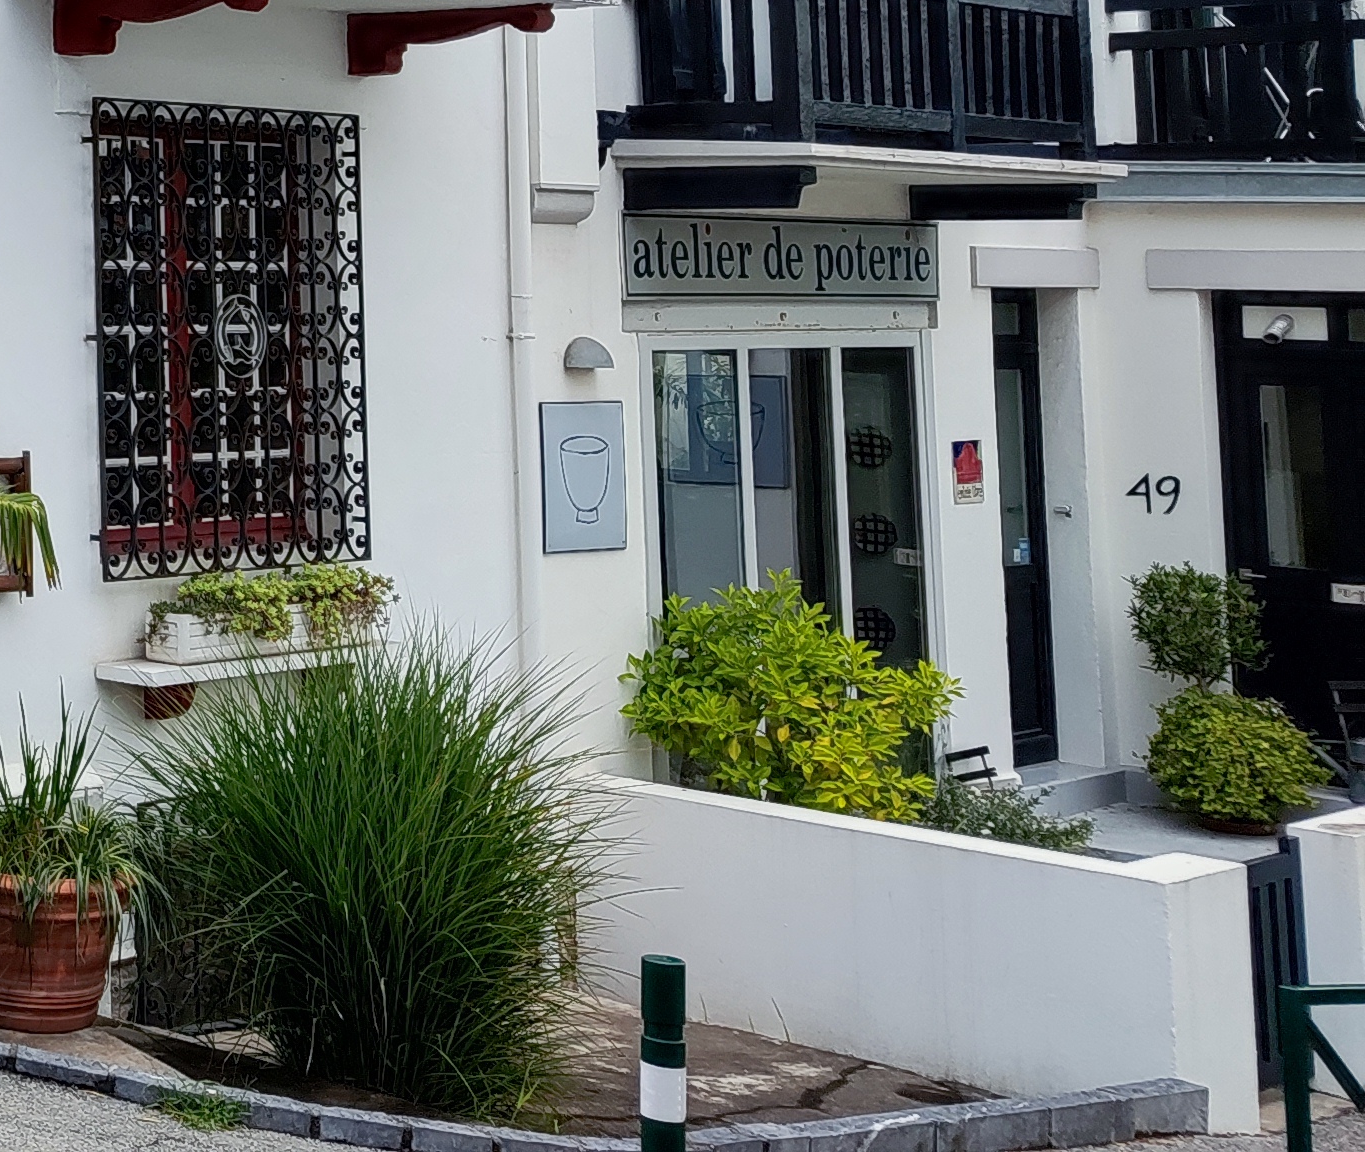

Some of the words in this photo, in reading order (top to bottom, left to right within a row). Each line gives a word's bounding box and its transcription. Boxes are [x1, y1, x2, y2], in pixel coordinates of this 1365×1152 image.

[632, 222, 753, 279] atelier
[763, 225, 804, 280] de
[813, 229, 931, 291] poterie
[1125, 472, 1180, 515] 49
